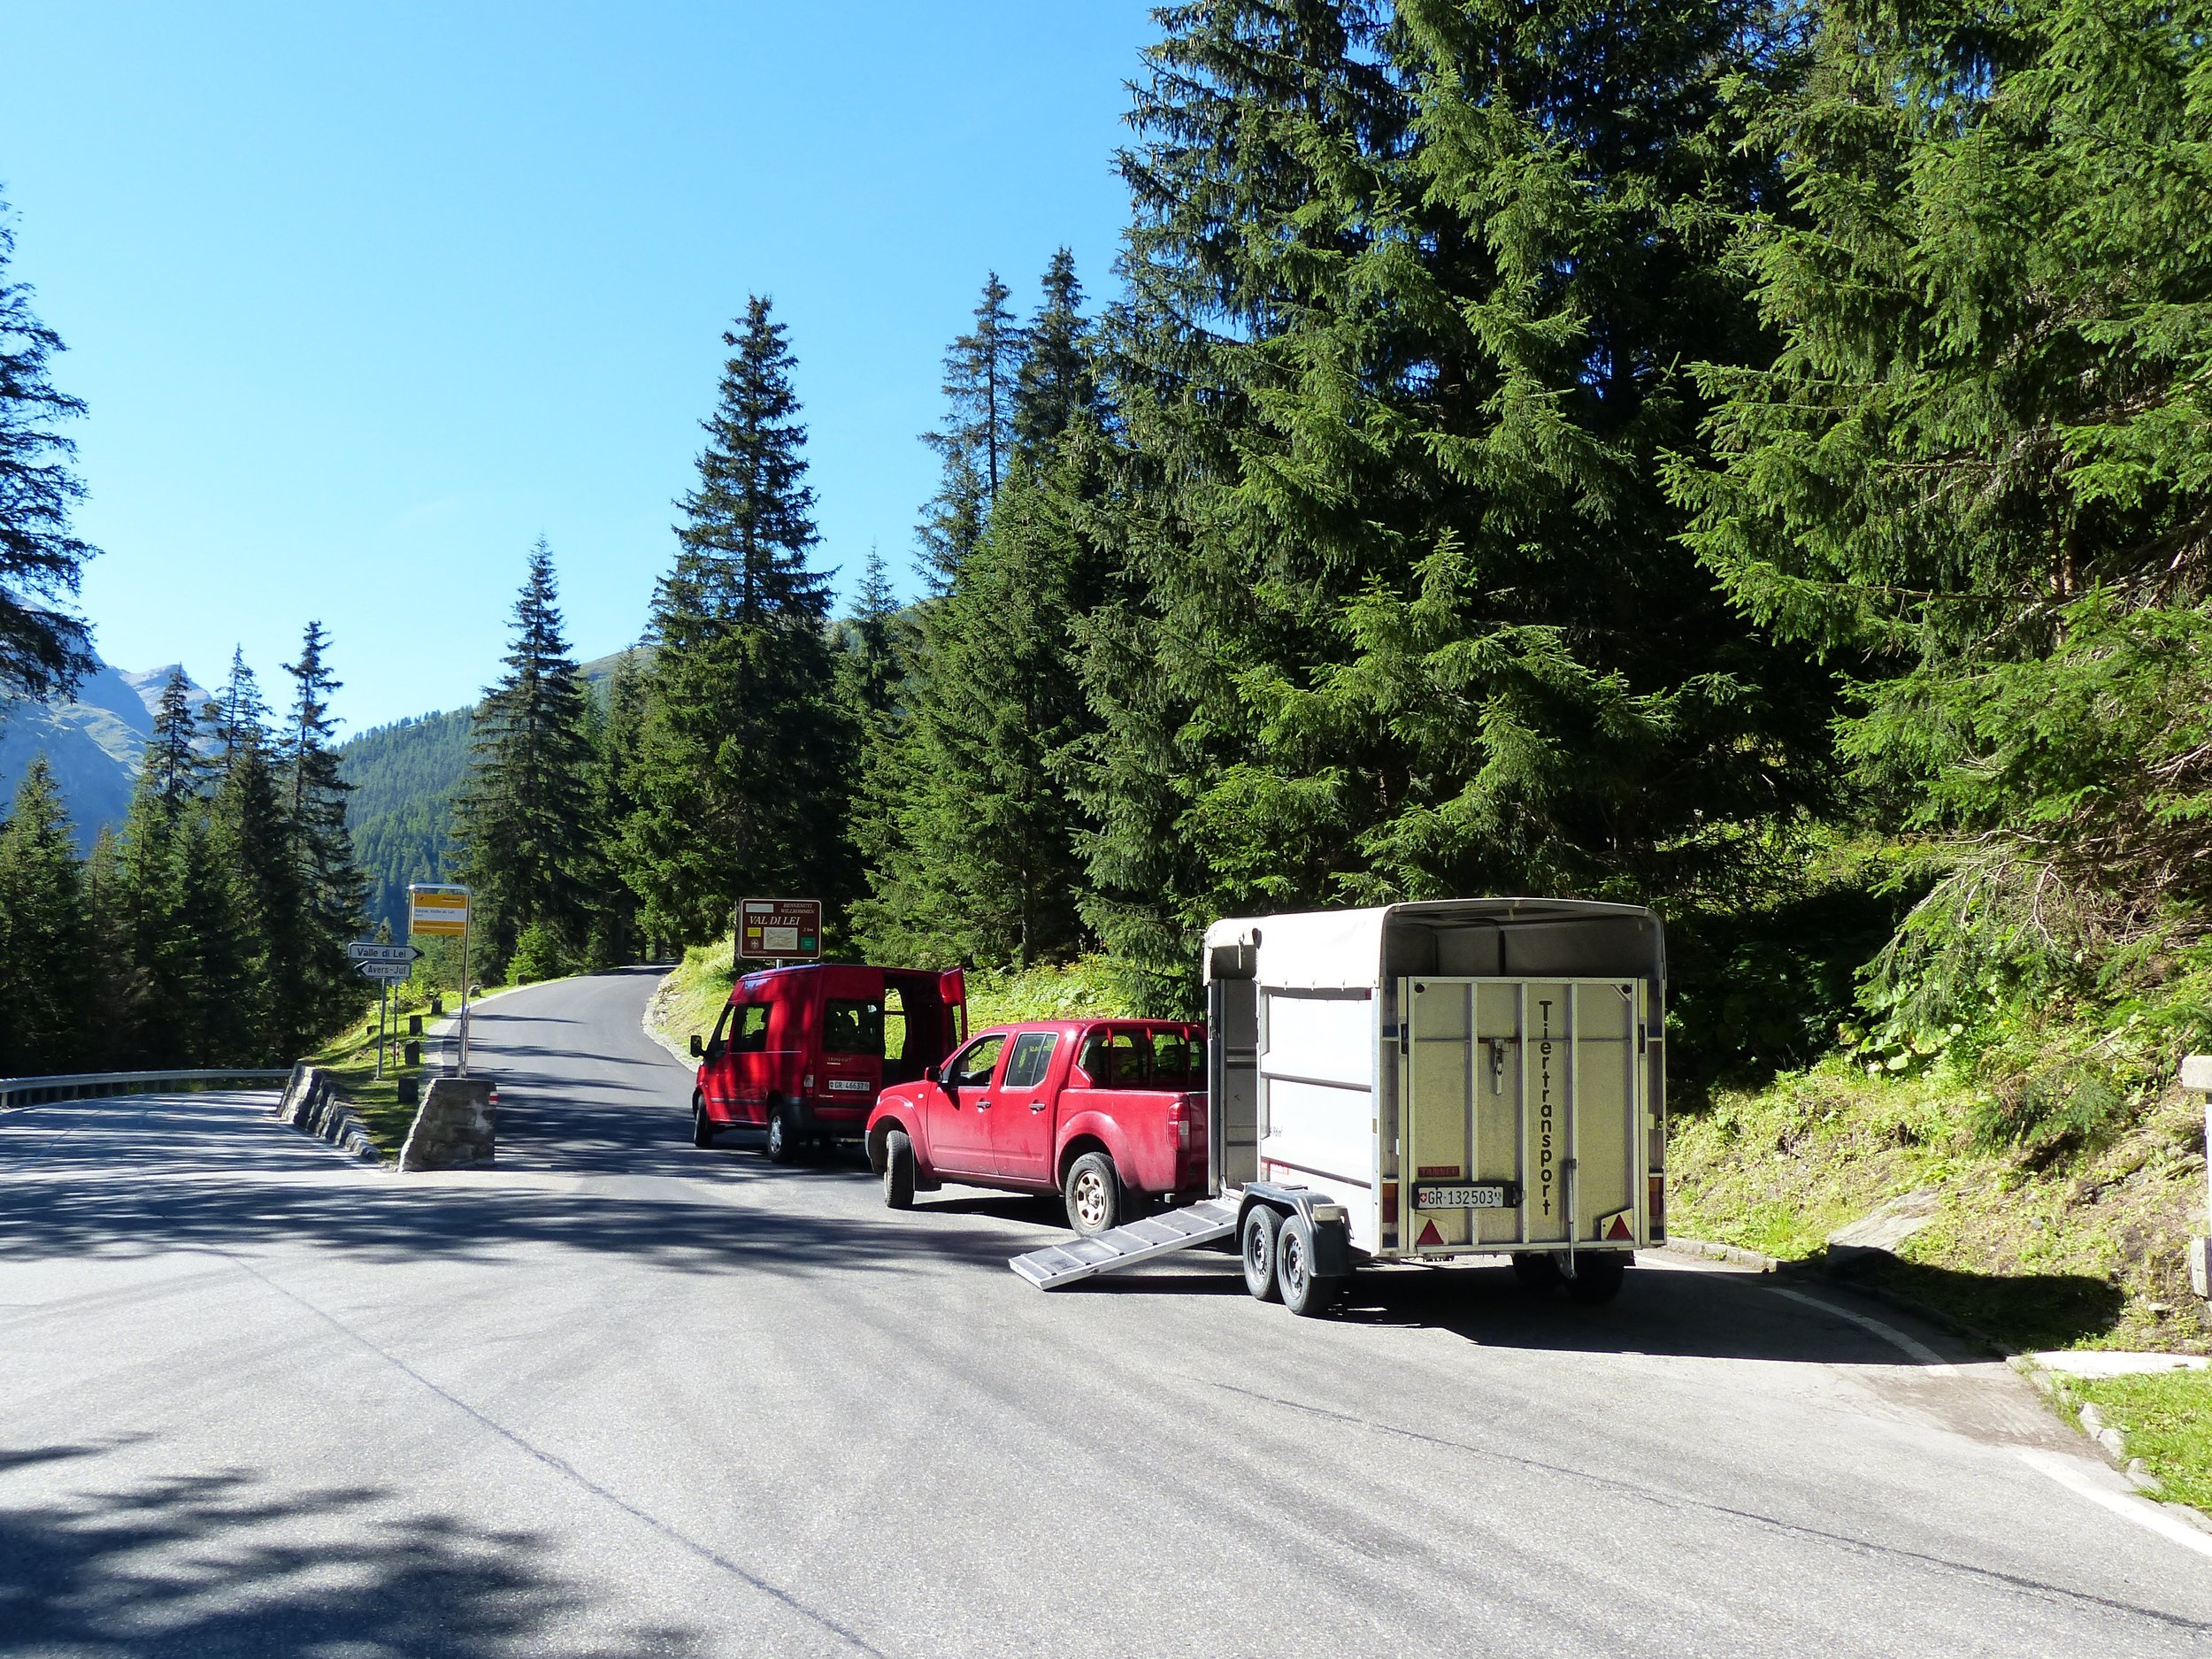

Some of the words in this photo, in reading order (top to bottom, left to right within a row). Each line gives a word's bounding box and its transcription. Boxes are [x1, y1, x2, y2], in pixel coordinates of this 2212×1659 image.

[749, 916, 768, 925] VAL
[770, 916, 781, 926] DI
[782, 916, 801, 926] LEI
[357, 948, 379, 957] Valle
[381, 948, 389, 957] di
[393, 949, 406, 958] Lei
[367, 964, 406, 974] Avers-Juf
[1539, 1000, 1553, 1217] Tiertransport
